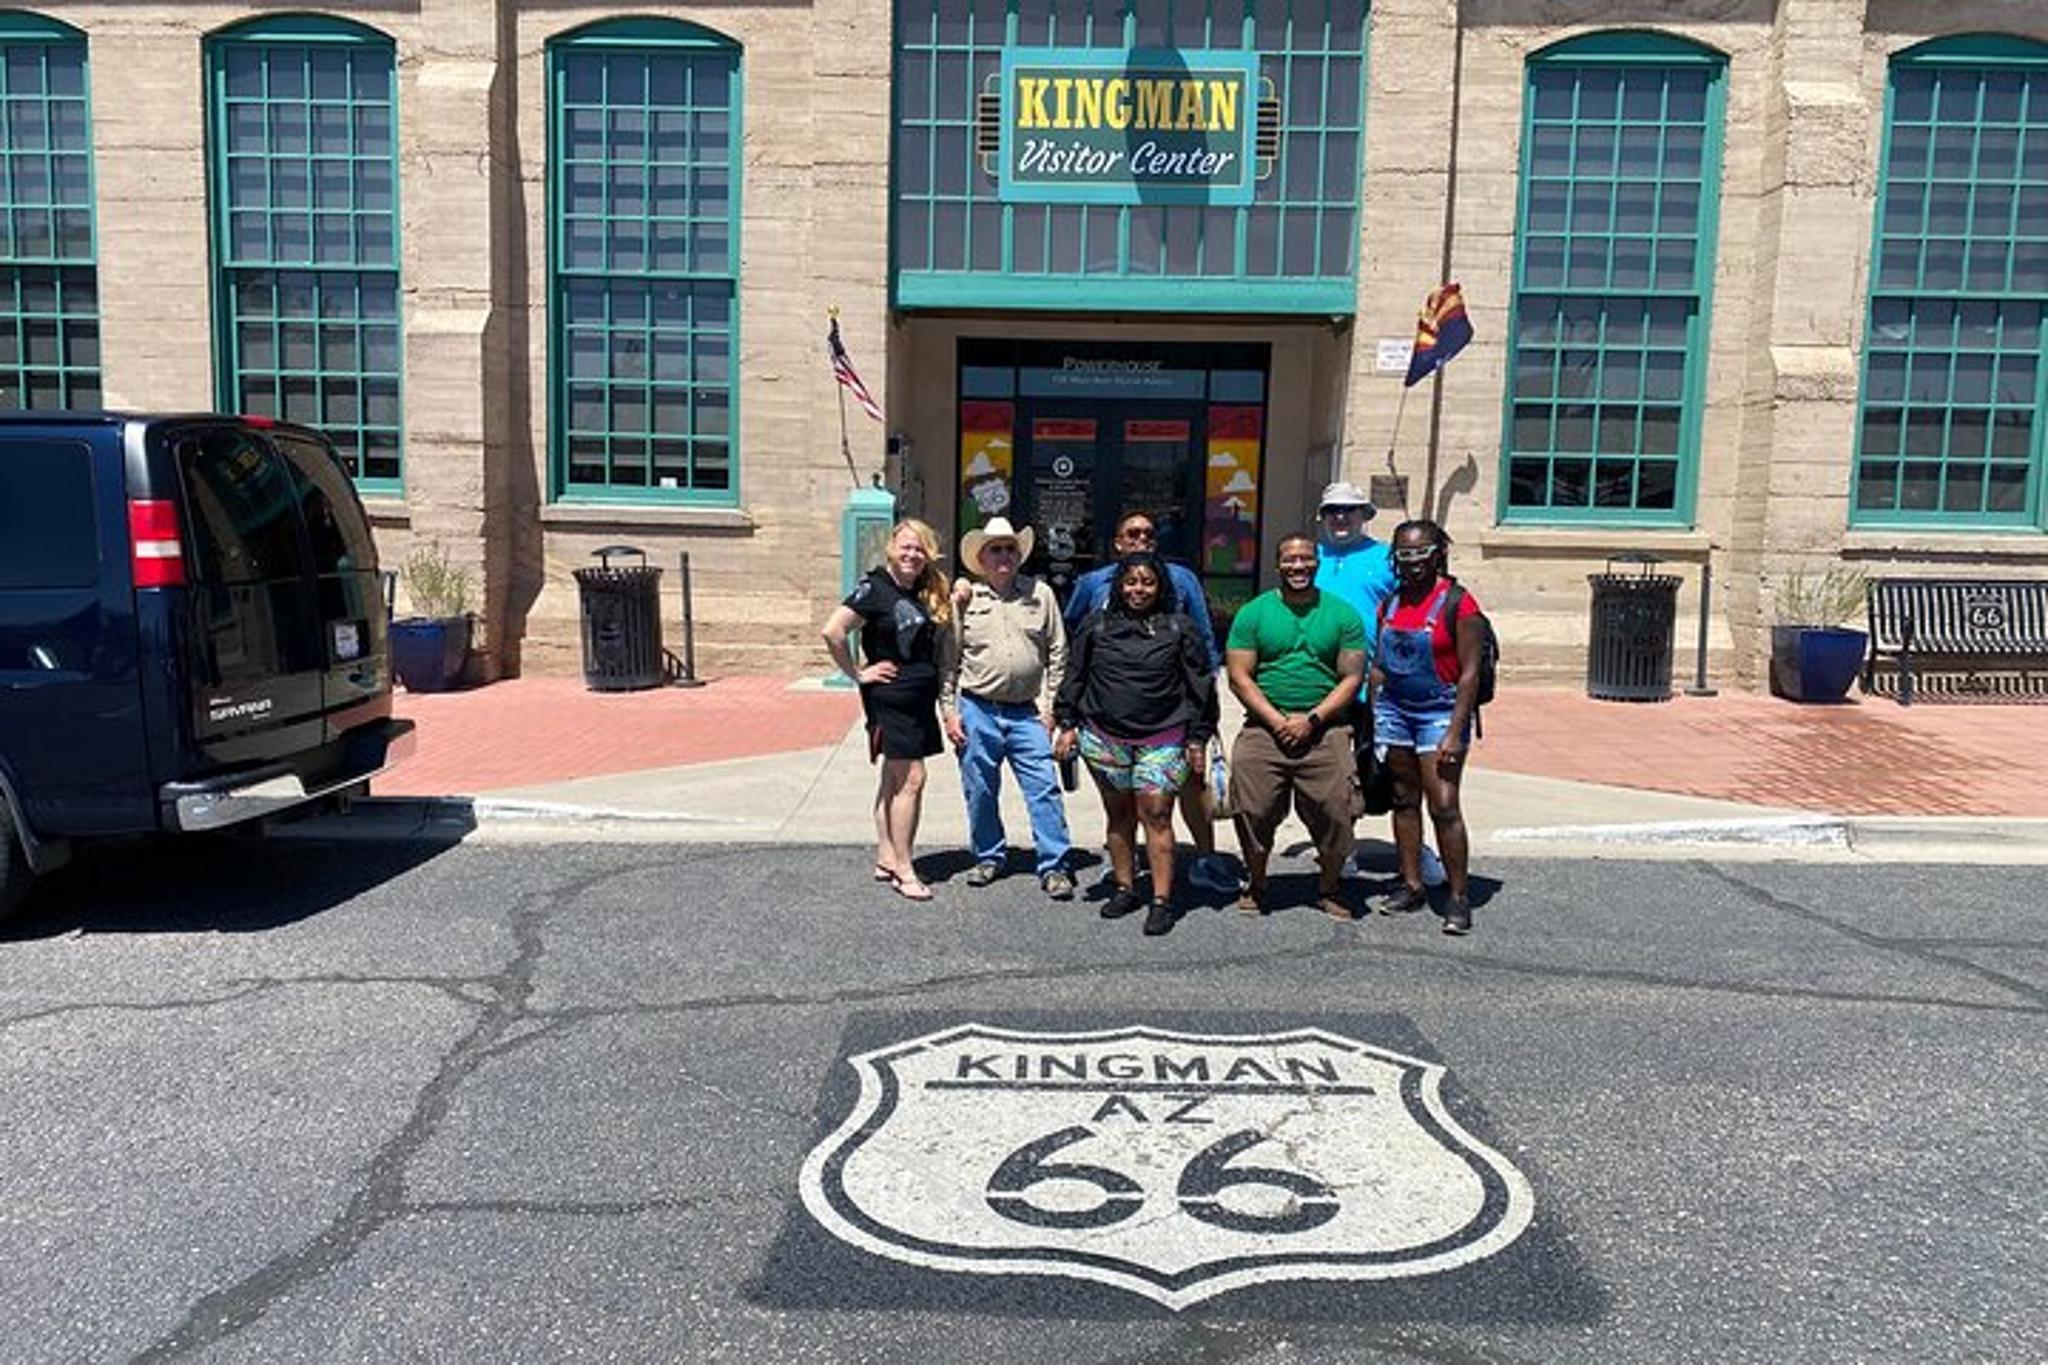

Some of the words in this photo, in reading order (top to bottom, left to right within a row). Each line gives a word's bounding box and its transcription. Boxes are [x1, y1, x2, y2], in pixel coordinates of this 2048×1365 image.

[1017, 78, 1239, 132] KINGMAN
[1018, 139, 1124, 174] Visitor
[1130, 141, 1234, 175] Center
[1973, 607, 2001, 626] 66
[956, 1053, 1341, 1082] KINGMAN
[1092, 1094, 1214, 1124] AZ
[986, 1125, 1340, 1234] 66
